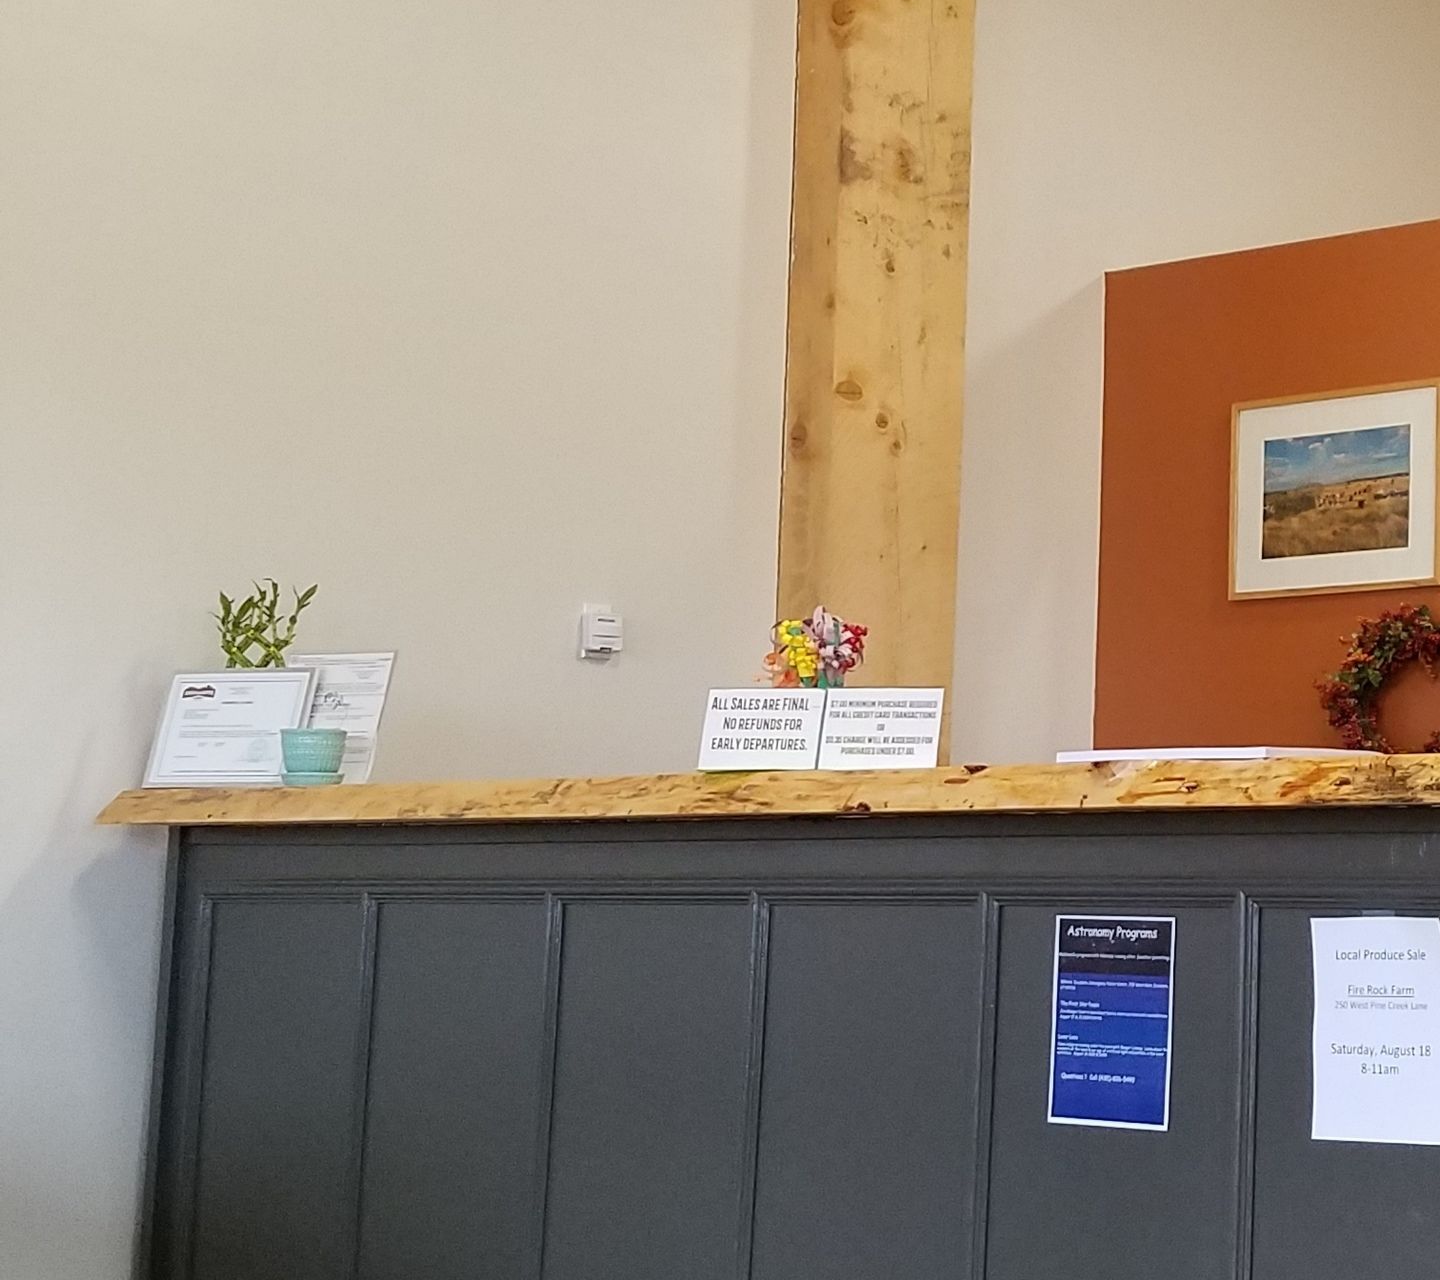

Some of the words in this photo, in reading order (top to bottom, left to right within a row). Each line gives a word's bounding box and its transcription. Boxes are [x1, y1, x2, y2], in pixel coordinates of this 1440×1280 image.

[711, 696, 728, 710] ALL
[730, 697, 760, 710] SALES
[761, 698, 781, 710] ARE
[782, 698, 810, 711] FINAL
[723, 717, 737, 730] NO
[738, 717, 783, 730] REFUNDS
[784, 718, 803, 730] FOR
[711, 737, 743, 750] EARLY
[743, 738, 808, 751] DEPARTURES.
[1067, 925, 1115, 940] Astronomy
[1116, 925, 1158, 941] Programs
[1335, 948, 1361, 960] Local
[1363, 947, 1405, 960] Produce
[1406, 948, 1426, 960] Sale
[1347, 984, 1365, 995] Fire
[1366, 984, 1388, 995] Rock
[1391, 985, 1415, 995] Farm
[1330, 1042, 1378, 1058] Saturday,
[1379, 1044, 1416, 1059] August
[1419, 1045, 1432, 1057] 18
[1360, 1062, 1400, 1075] 8-11am
